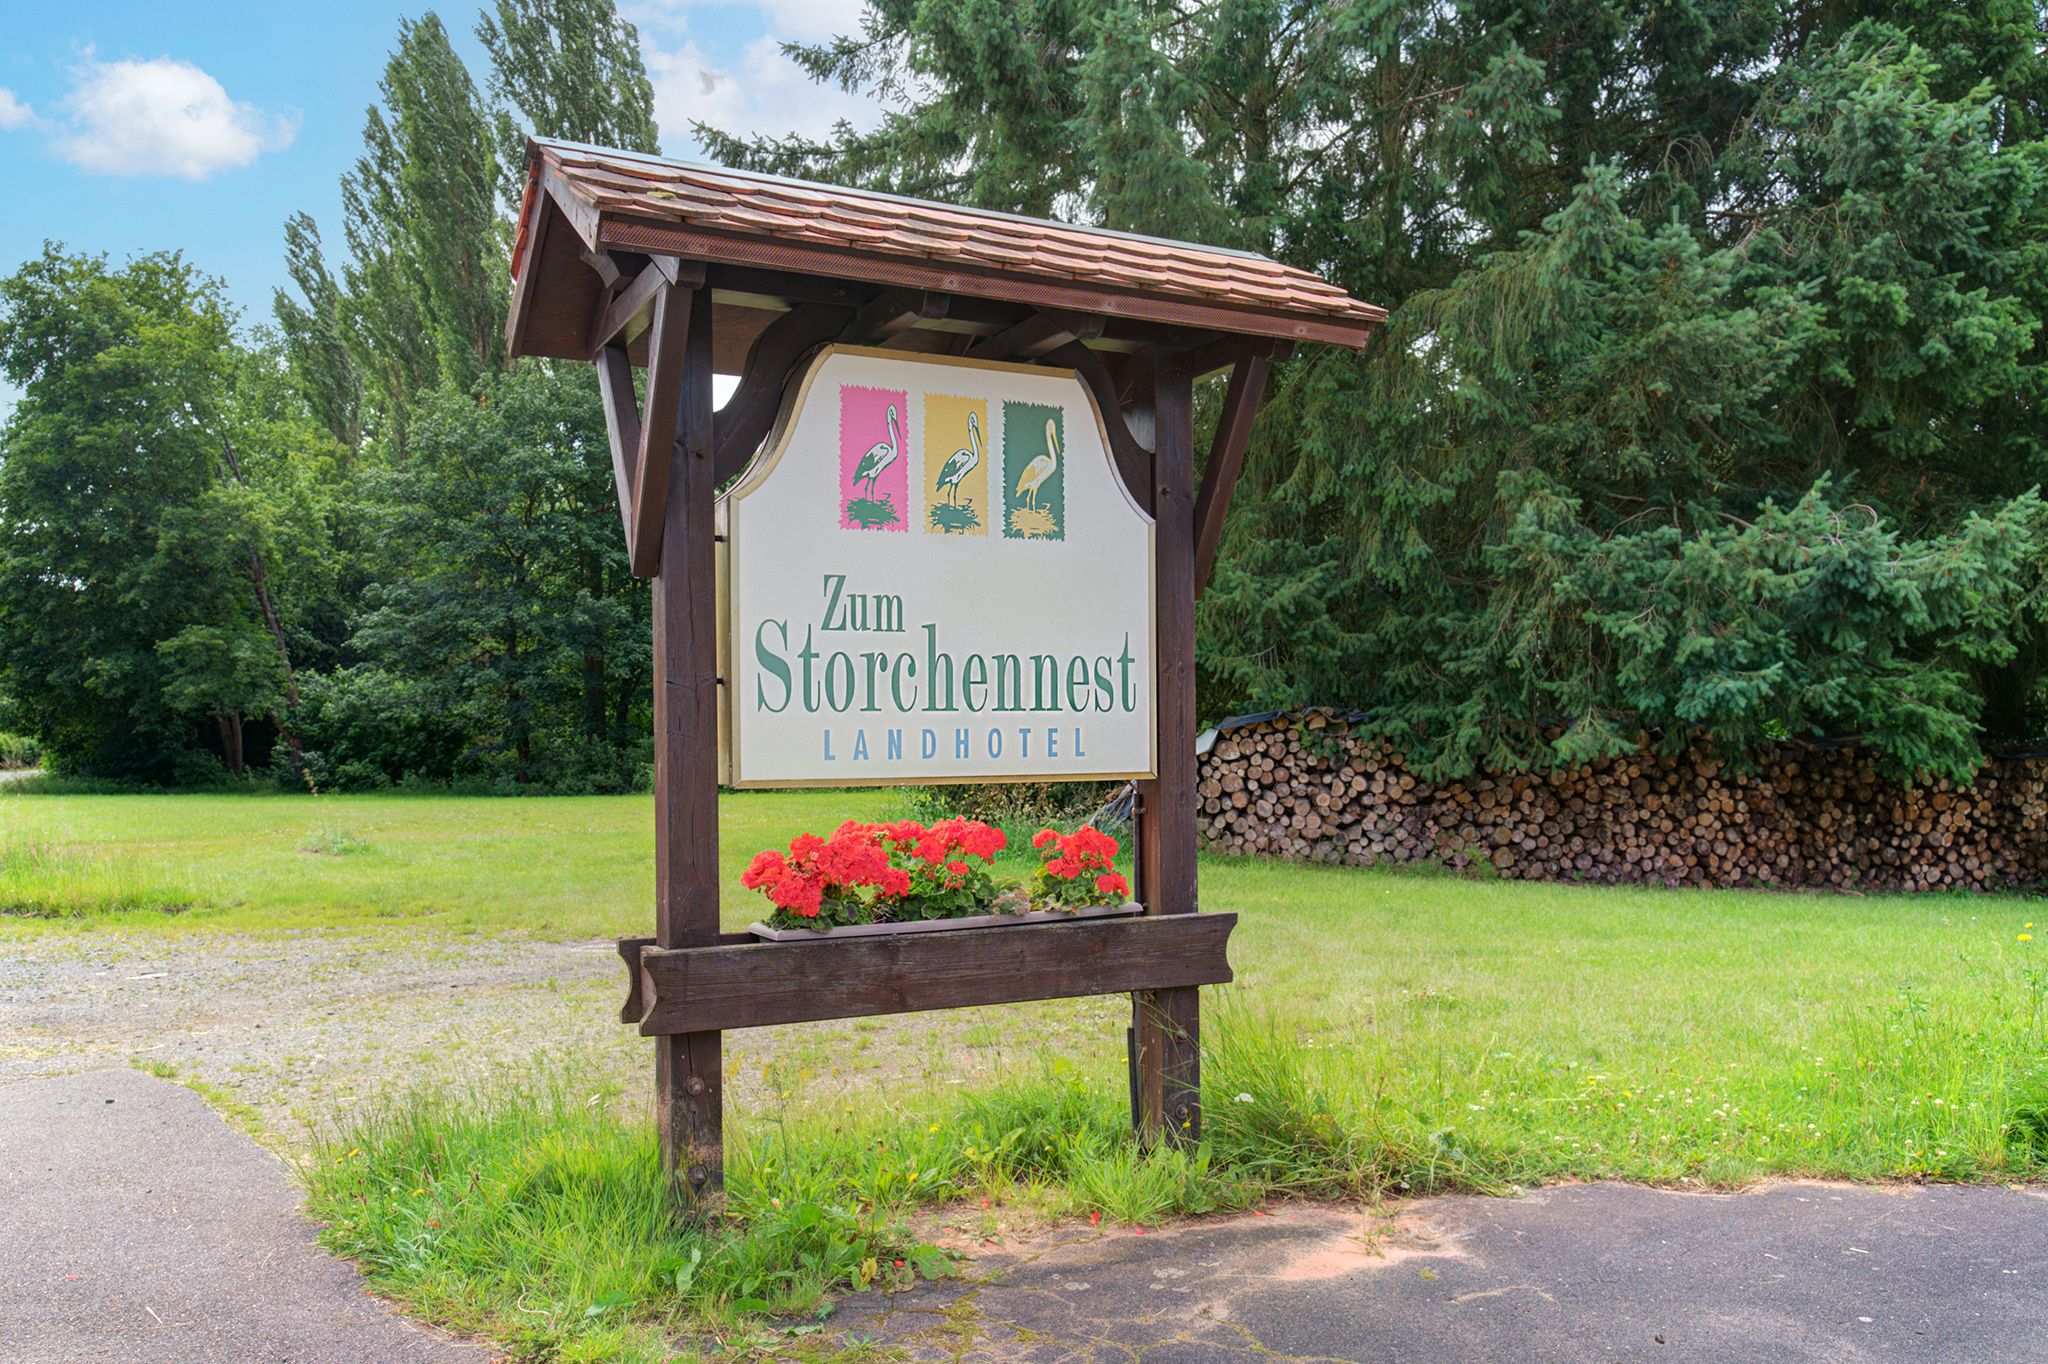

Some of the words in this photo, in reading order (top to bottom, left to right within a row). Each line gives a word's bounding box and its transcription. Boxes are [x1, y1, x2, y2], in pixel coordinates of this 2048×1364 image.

[820, 574, 906, 632] Zum
[755, 619, 1137, 713] Storchennest
[824, 728, 1086, 760] LANDHOTEL
